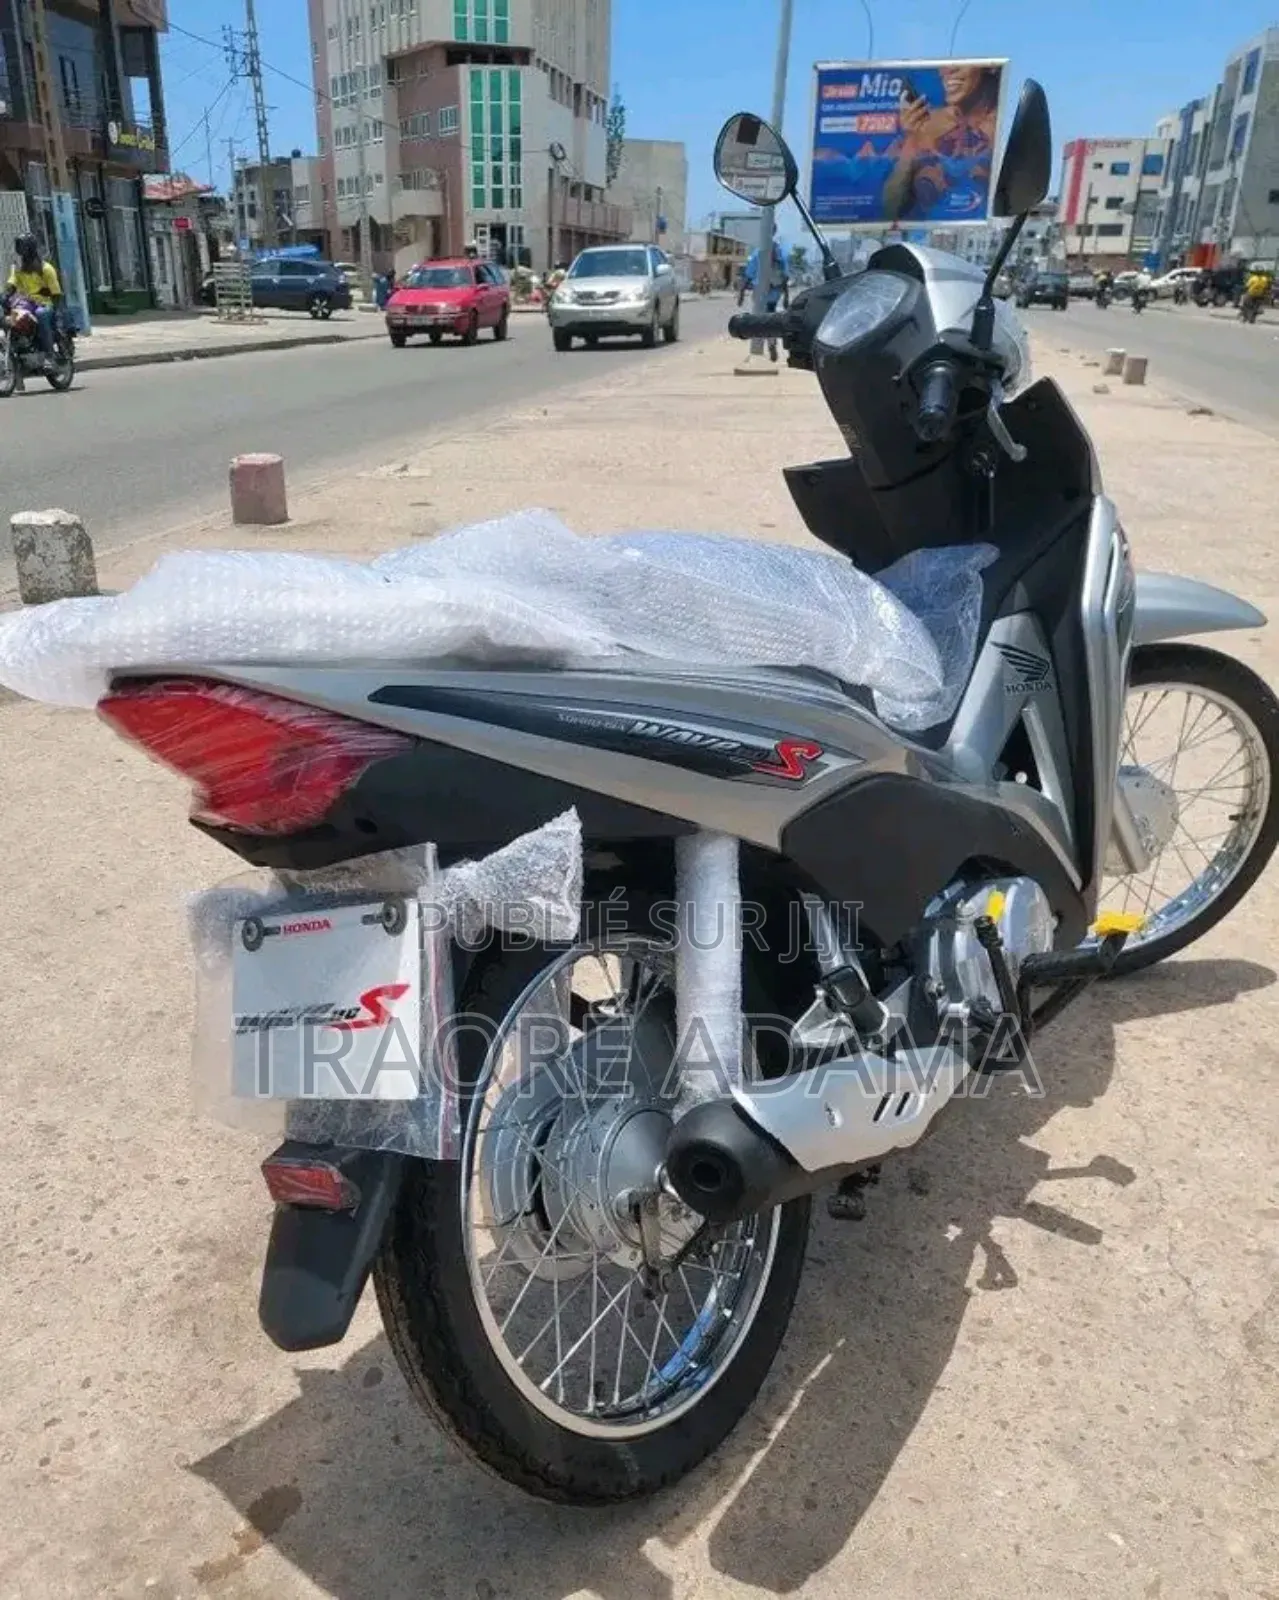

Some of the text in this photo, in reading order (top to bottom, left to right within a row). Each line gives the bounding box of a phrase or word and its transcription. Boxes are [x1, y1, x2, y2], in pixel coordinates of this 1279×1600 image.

[859, 73, 902, 98] Mio
[1004, 681, 1053, 694] HONDA
[752, 735, 825, 780] S
[282, 919, 331, 936] HONDA
[323, 984, 411, 1029] S
